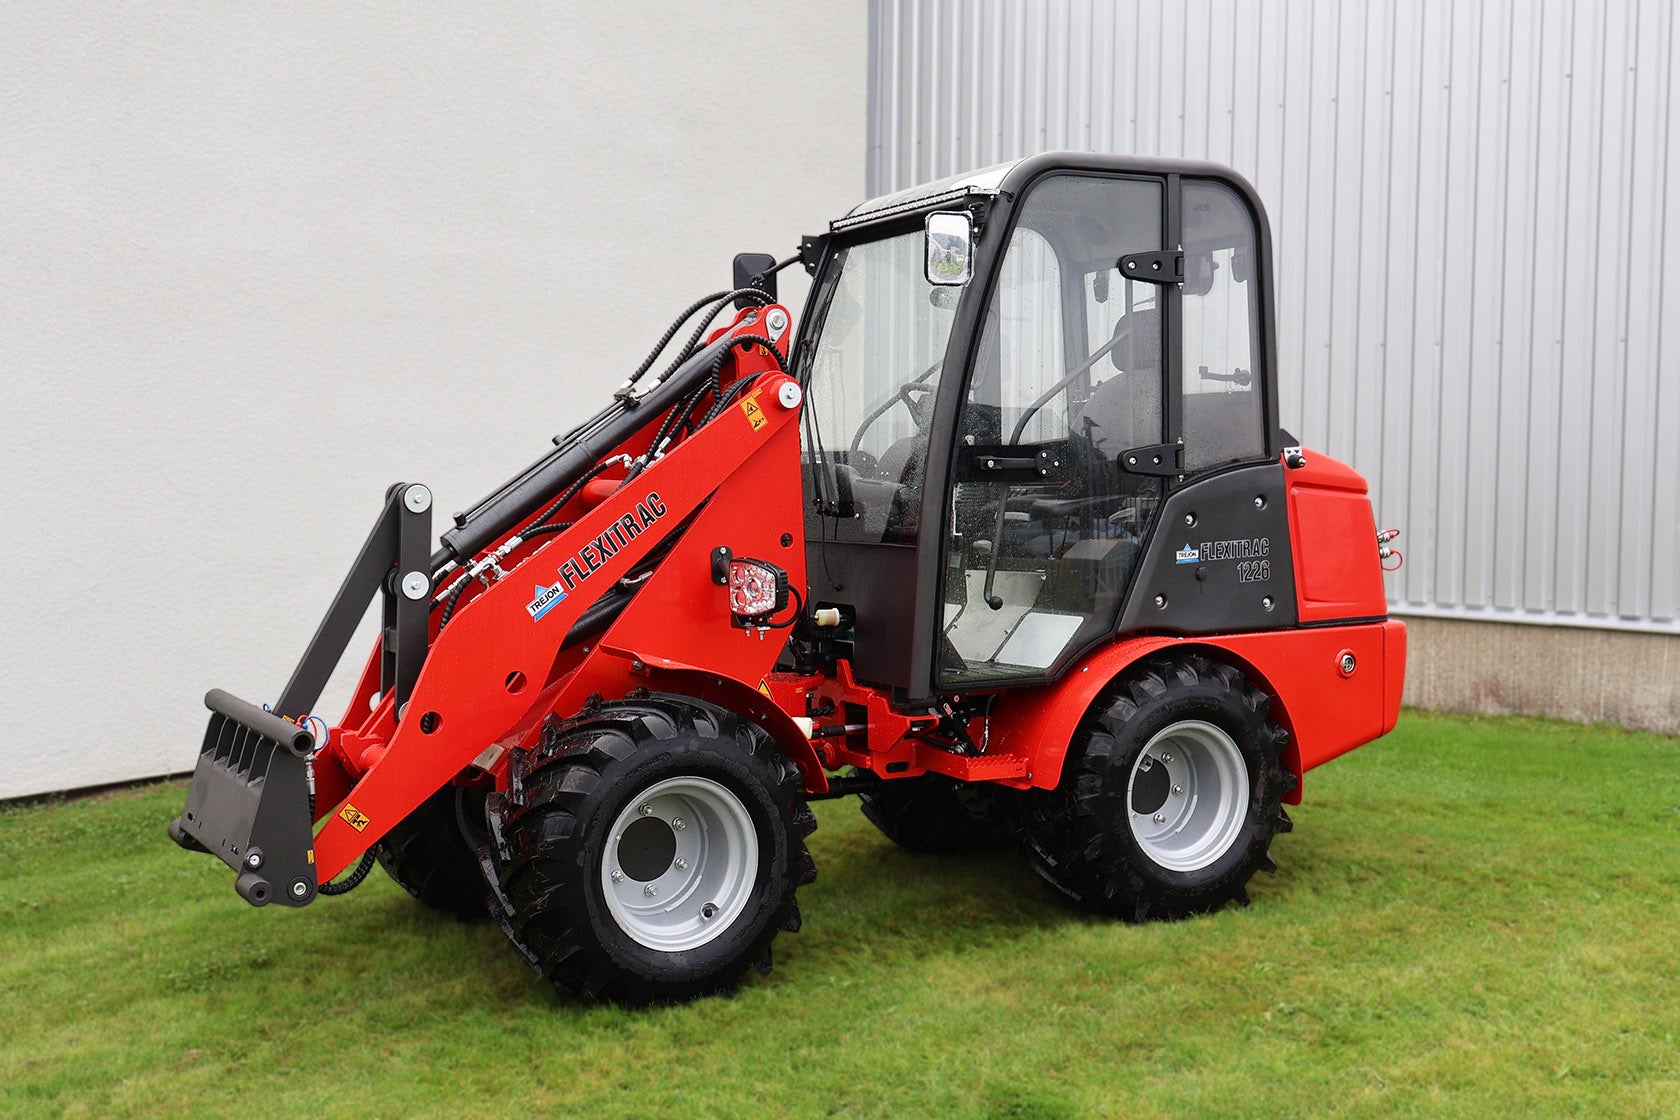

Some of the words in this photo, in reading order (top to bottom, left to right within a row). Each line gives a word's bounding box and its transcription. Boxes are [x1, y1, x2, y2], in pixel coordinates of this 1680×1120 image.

[528, 585, 561, 613] TREJON
[557, 492, 667, 590] FLEXITRAC
[1200, 538, 1269, 561] FLEXITRAC
[1237, 560, 1270, 582] 1226
